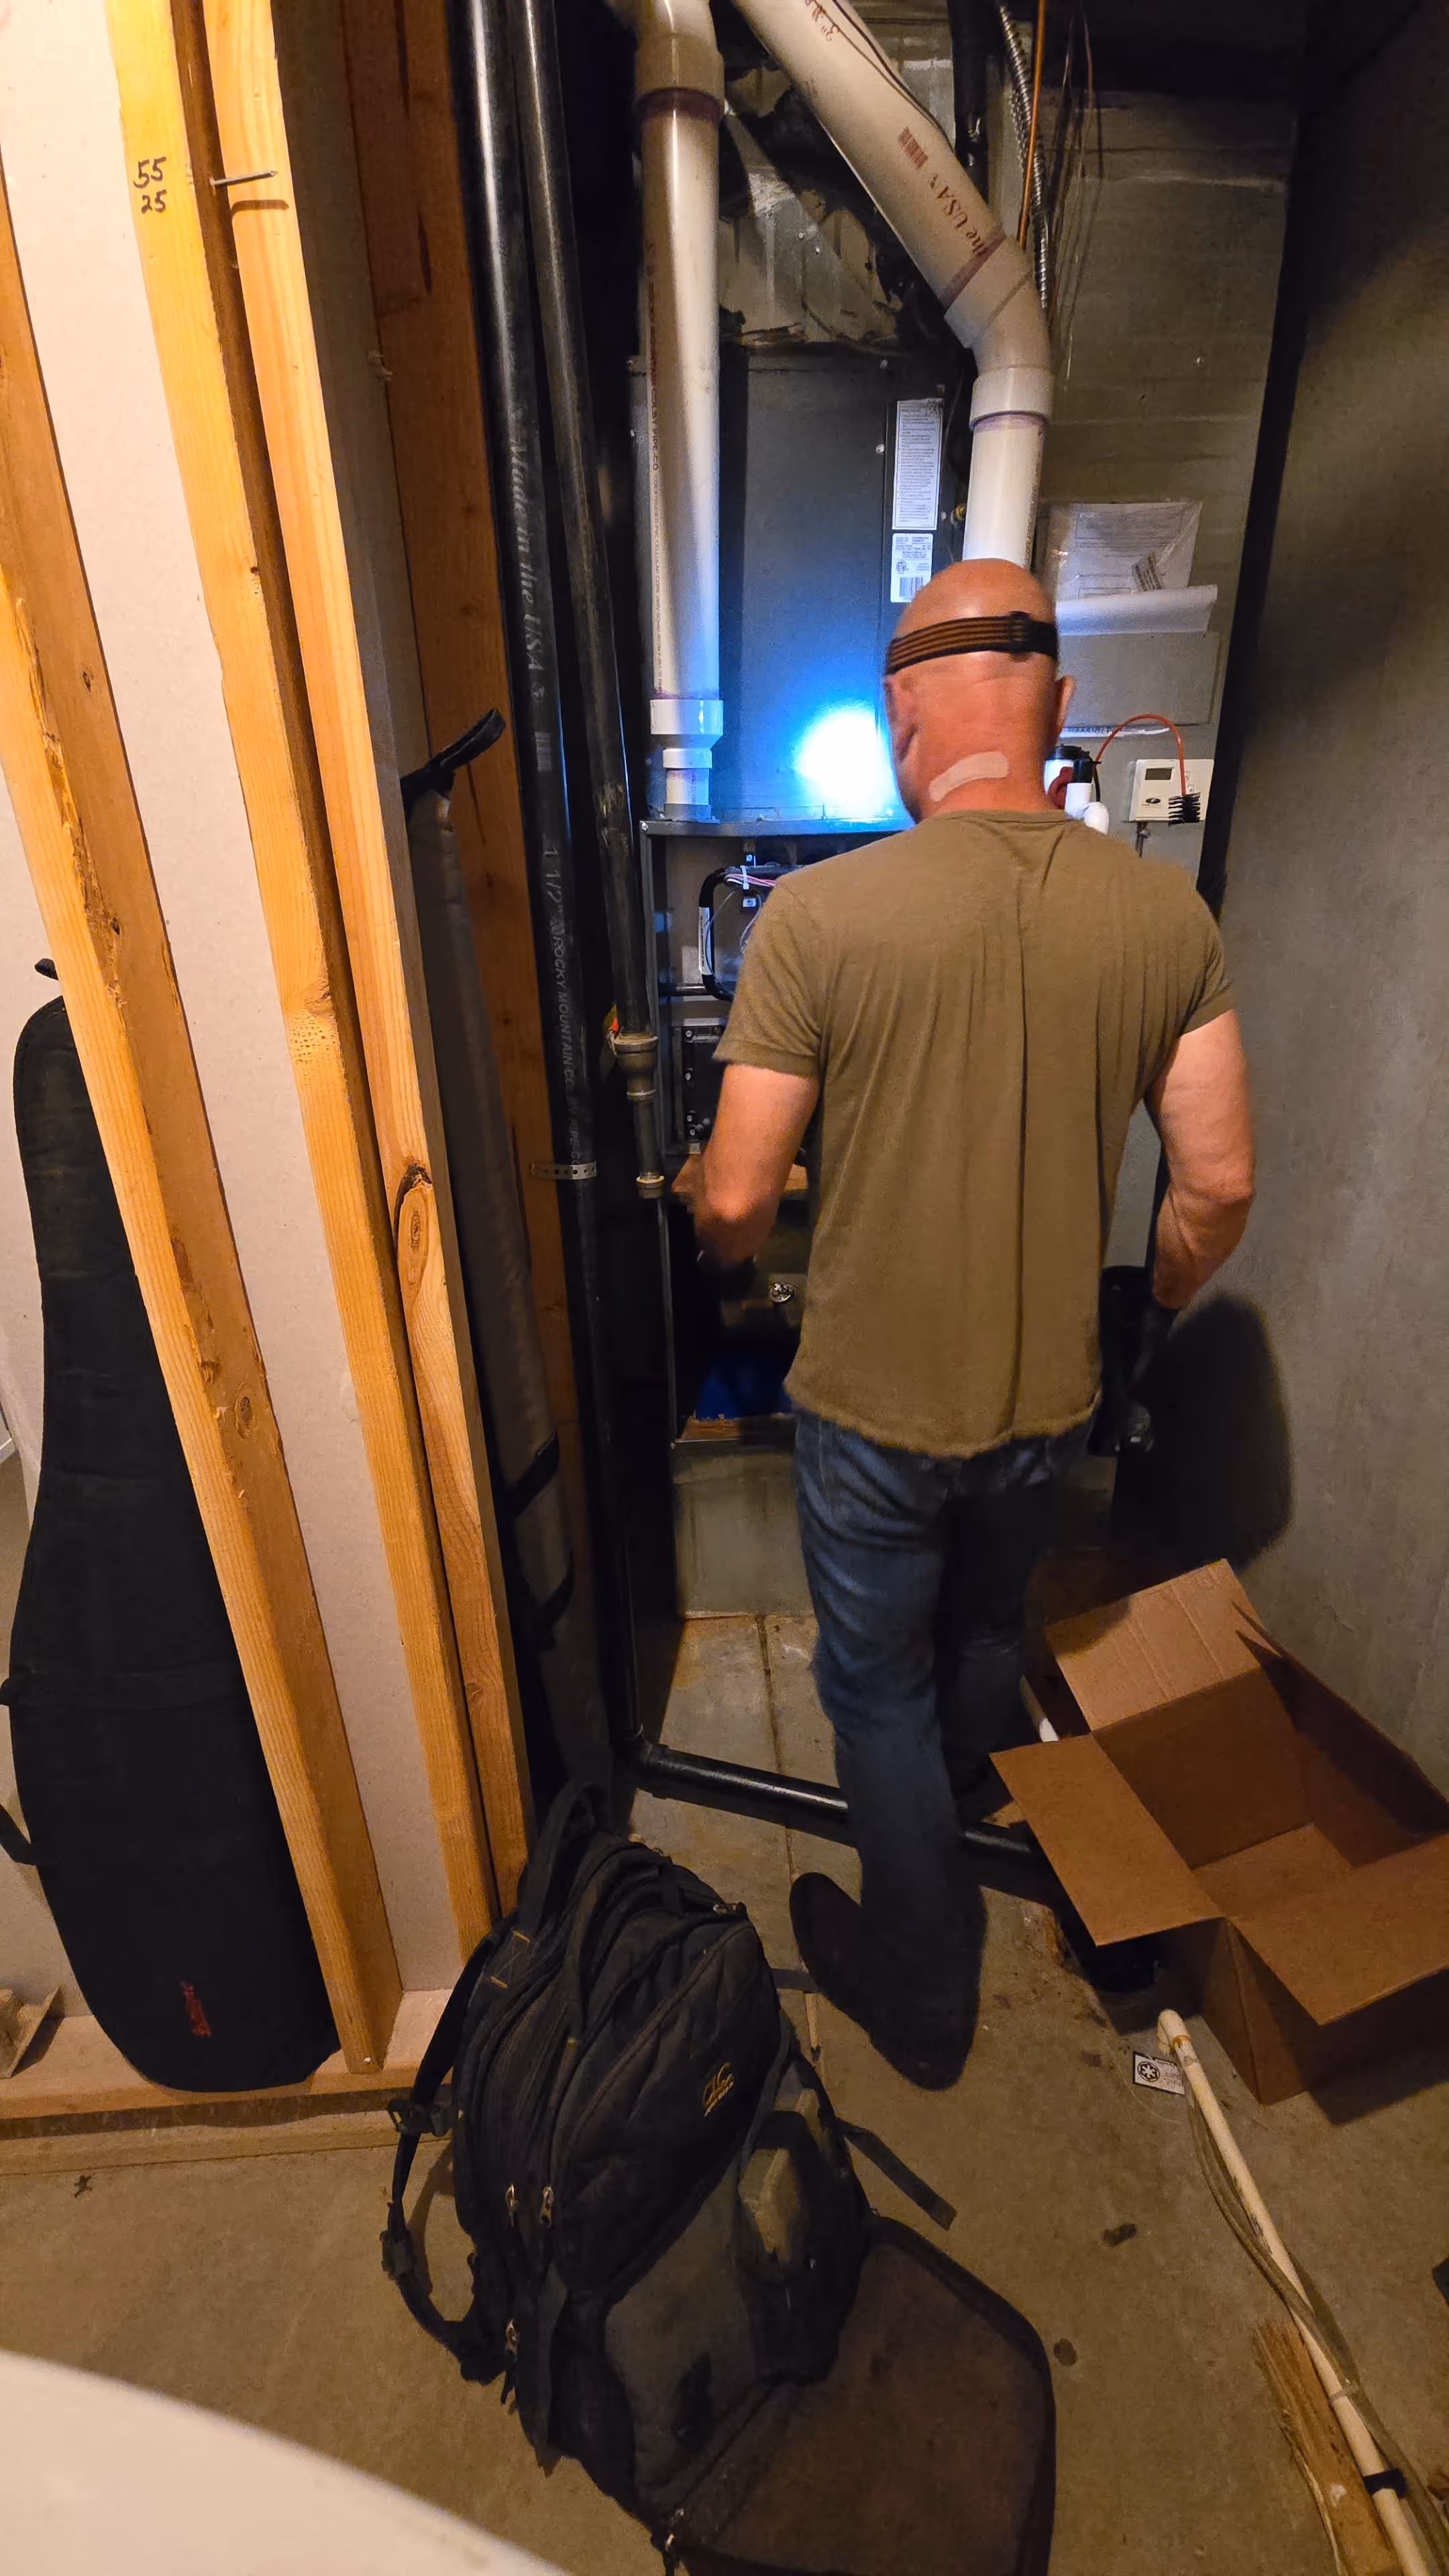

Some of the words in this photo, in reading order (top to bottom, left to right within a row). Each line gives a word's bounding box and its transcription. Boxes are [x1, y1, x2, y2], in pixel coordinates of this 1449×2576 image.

[133, 156, 167, 189] 55
[141, 189, 167, 214] 25
[936, 186, 967, 229] USA
[510, 439, 528, 513] Made
[517, 527, 531, 553] in
[520, 562, 537, 604] the
[524, 614, 545, 670] USA
[553, 936, 568, 989] ROCKY
[557, 991, 574, 1065] MOUNTAIN
